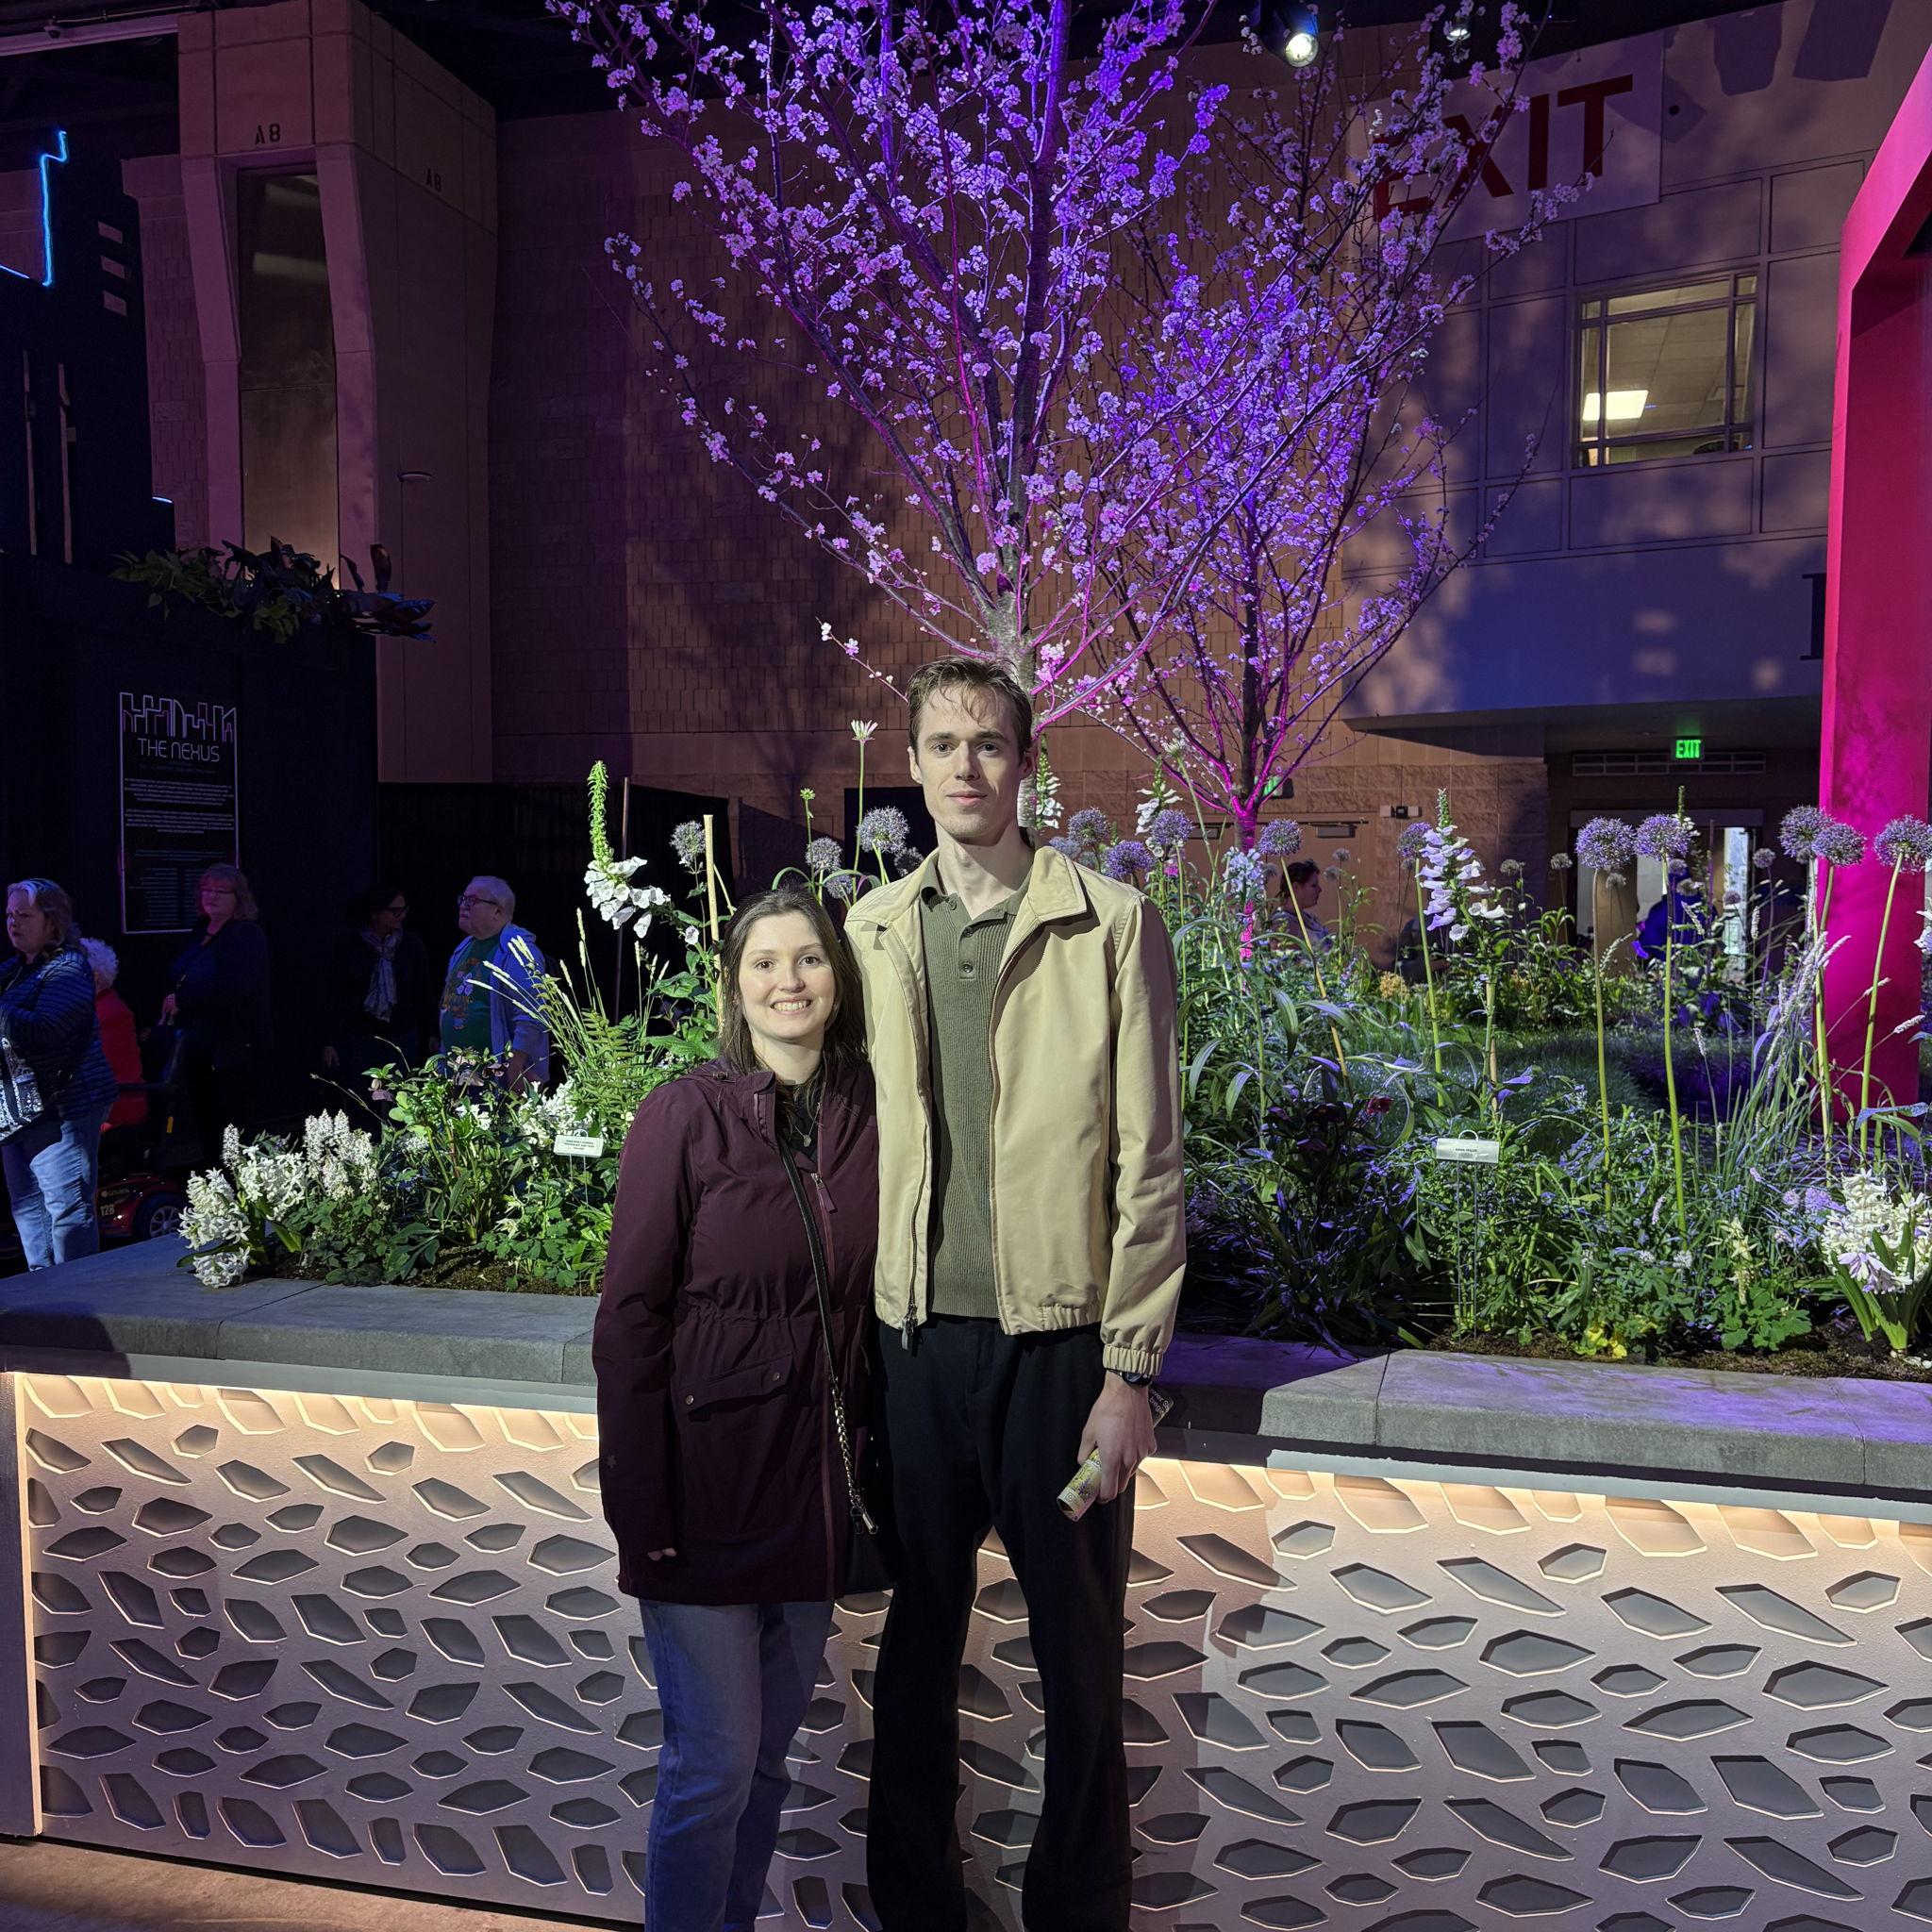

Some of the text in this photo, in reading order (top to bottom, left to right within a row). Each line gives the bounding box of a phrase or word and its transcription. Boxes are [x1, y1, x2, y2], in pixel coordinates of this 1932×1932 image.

[1373, 75, 1633, 222] EXIT
[137, 738, 167, 758] THE
[1675, 739, 1702, 758] EXIT
